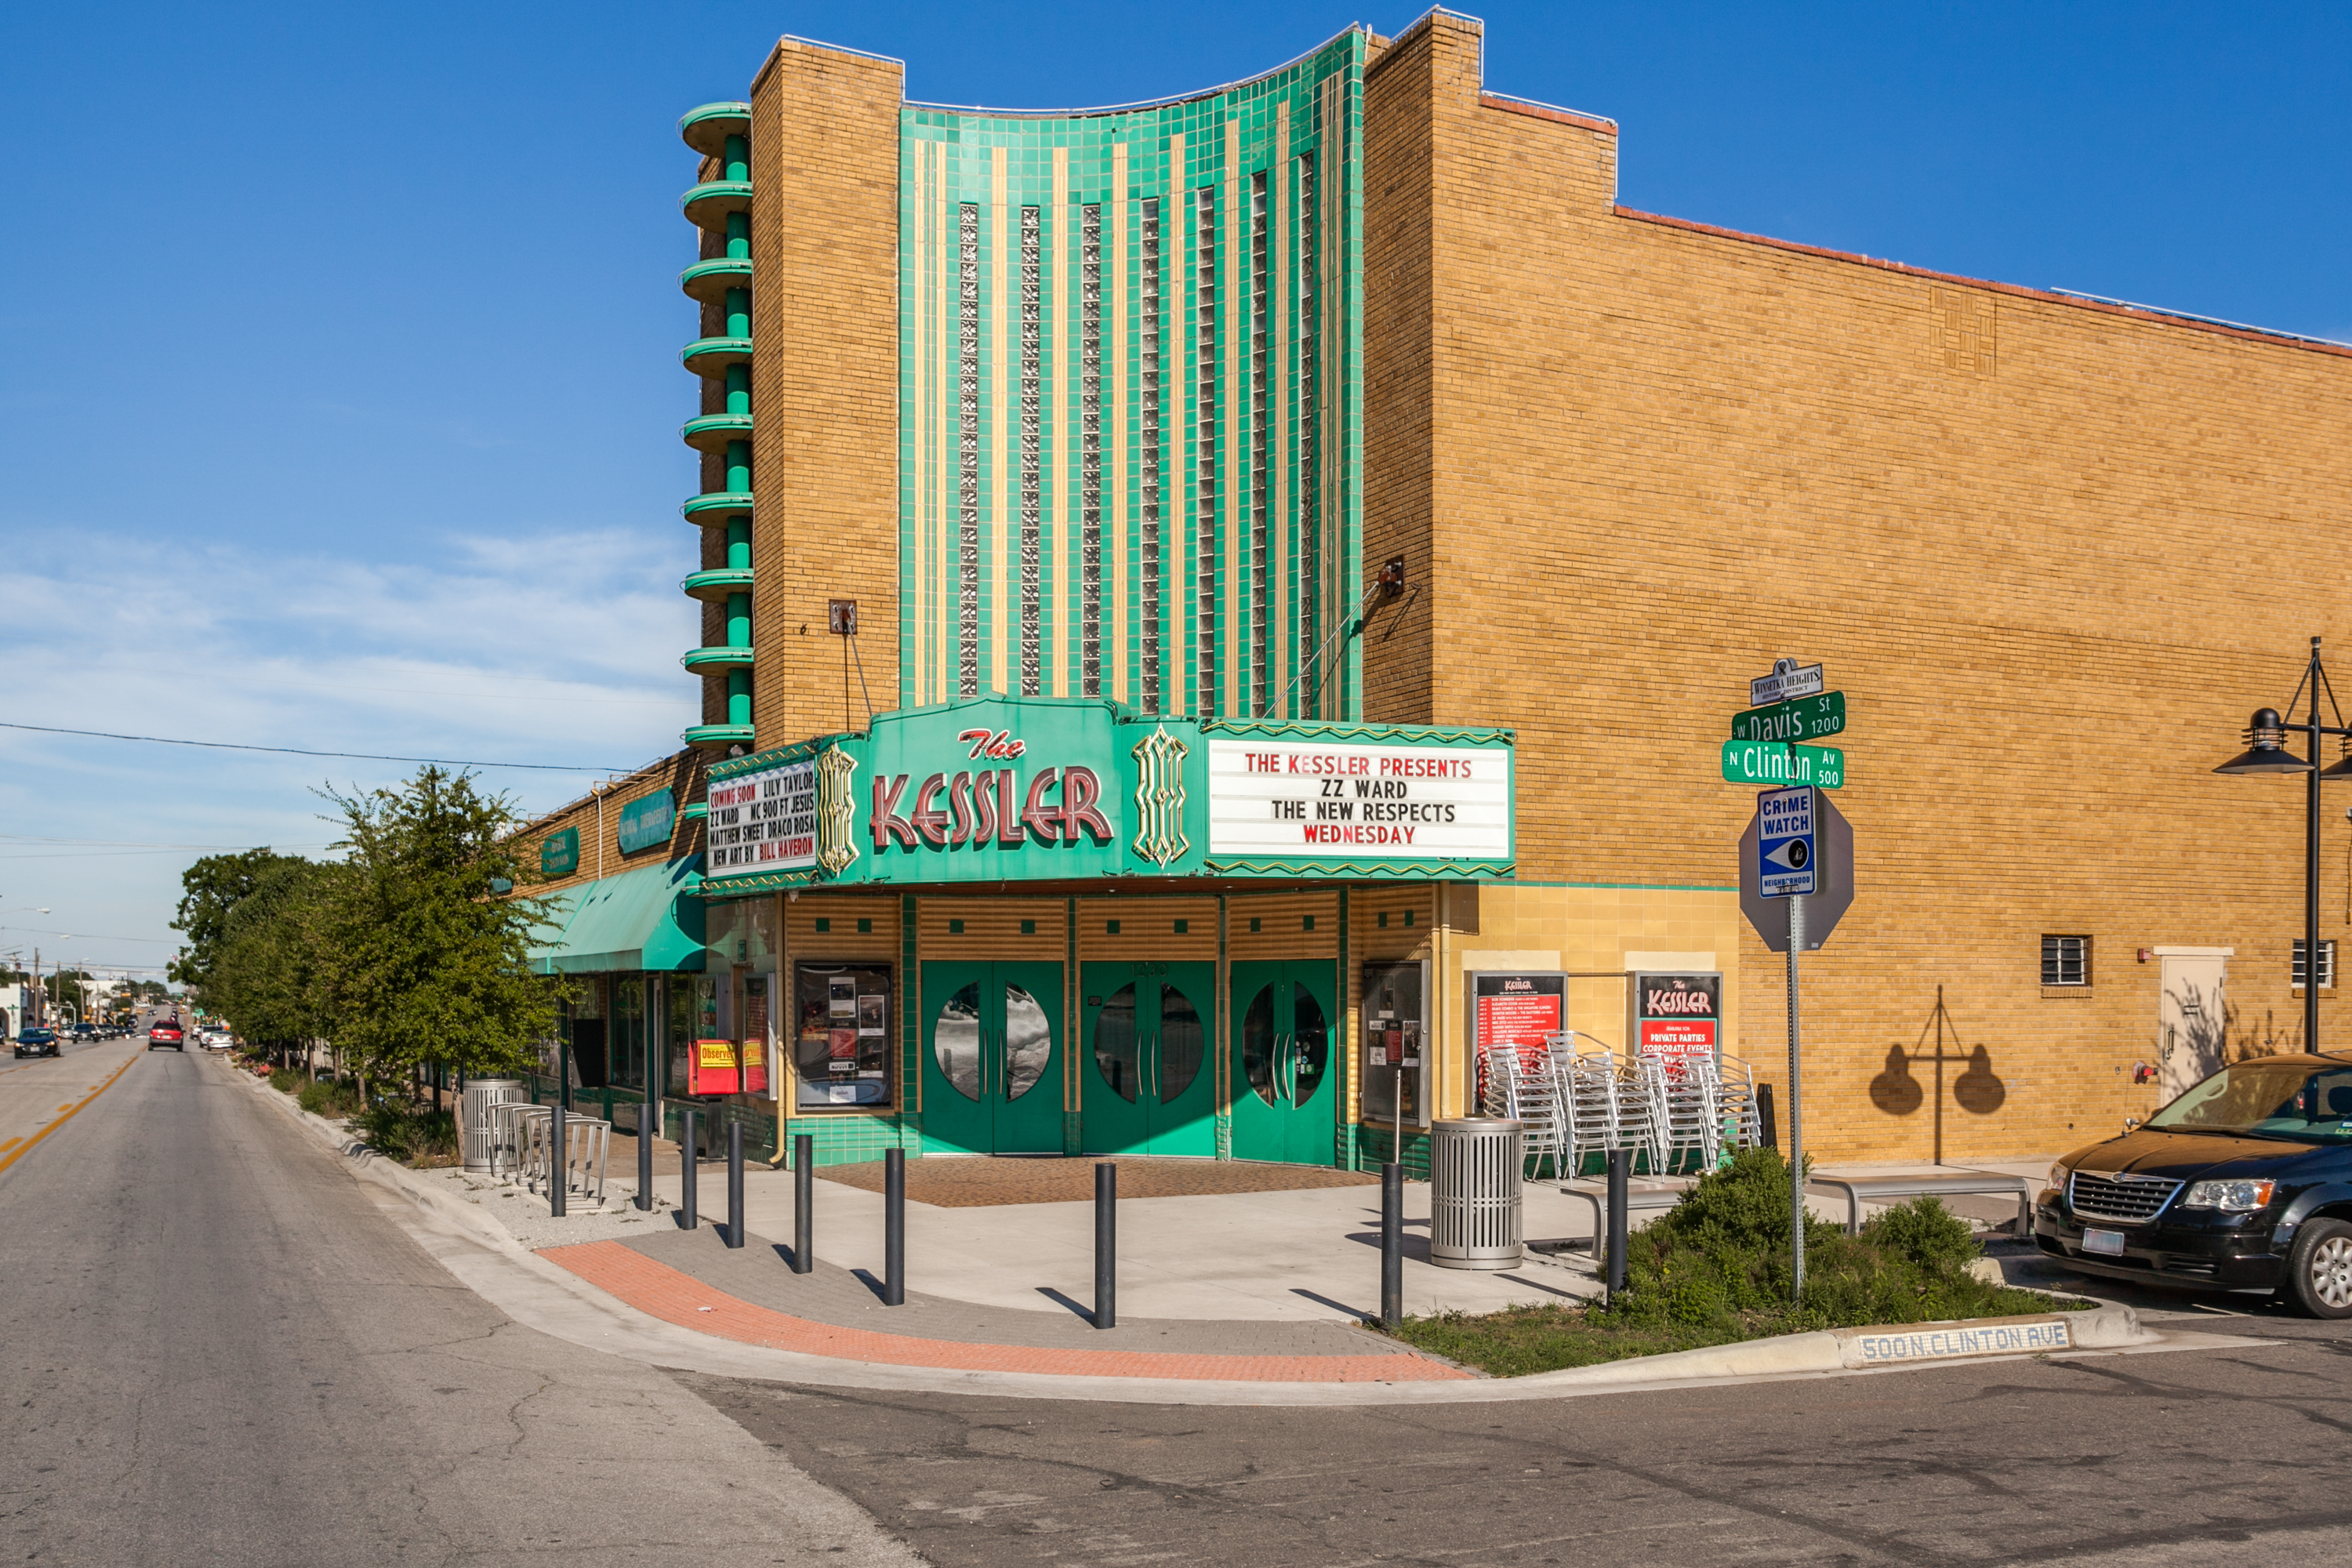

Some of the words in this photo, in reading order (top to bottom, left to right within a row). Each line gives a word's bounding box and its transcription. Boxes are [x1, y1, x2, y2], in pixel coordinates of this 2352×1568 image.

[1787, 669, 1820, 687] HEIGHTS
[1784, 685, 1808, 694] DISTRICT
[1737, 724, 1746, 739] W
[1751, 706, 1802, 742] Davis
[1819, 697, 1830, 712] St
[1812, 716, 1839, 734] 1200
[957, 728, 1025, 760] The
[1246, 753, 1280, 773] THE
[1289, 755, 1370, 775] KESSLER
[1381, 757, 1472, 778] PRESENTS
[1730, 752, 1737, 766] N
[1744, 746, 1810, 781] Clinton
[1823, 751, 1835, 764] Av
[764, 779, 781, 797] LILY
[783, 771, 813, 793] TAYLOR
[1819, 770, 1838, 786] 500
[710, 789, 735, 808] COMING
[738, 784, 755, 803] SOON
[1321, 779, 1344, 797] ZZ
[1356, 780, 1407, 800] WARD
[750, 804, 760, 821] MC
[763, 800, 778, 818] 900
[780, 798, 789, 815] FT
[791, 793, 814, 813] JESUS
[870, 766, 1115, 848] KESSLER
[1272, 800, 1306, 819] THE
[1316, 802, 1354, 821] NEW
[1363, 804, 1455, 822] RESPECTS
[1763, 796, 1808, 816] CRIME
[710, 811, 719, 827] ZZ
[721, 808, 739, 826] WARD
[1764, 815, 1809, 834] WATCH
[710, 827, 740, 847] MATTHEW
[742, 823, 764, 842] SWEET
[768, 818, 792, 838] DRACO
[794, 815, 815, 834] ROSA
[1303, 825, 1415, 844] WEDNESDAY
[713, 849, 726, 866] NEW
[730, 847, 742, 865] ART
[745, 845, 754, 862] BY
[760, 843, 775, 861] BILL
[779, 837, 813, 858] HAVERON
[1764, 876, 1810, 887] NEIGHBORHOOD
[1131, 964, 1167, 977] 1230
[1504, 980, 1532, 991] KESSLER
[1672, 980, 1686, 989] The
[1647, 989, 1712, 1015] KESSLER
[1650, 1033, 1677, 1042] PRIVATE
[1679, 1033, 1706, 1042] PARTIES
[702, 1047, 735, 1059] Observer
[1642, 1044, 1686, 1053] CORPORATE
[1931, 1328, 2022, 1355] CLINTON
[2027, 1325, 2067, 1347] AVE
